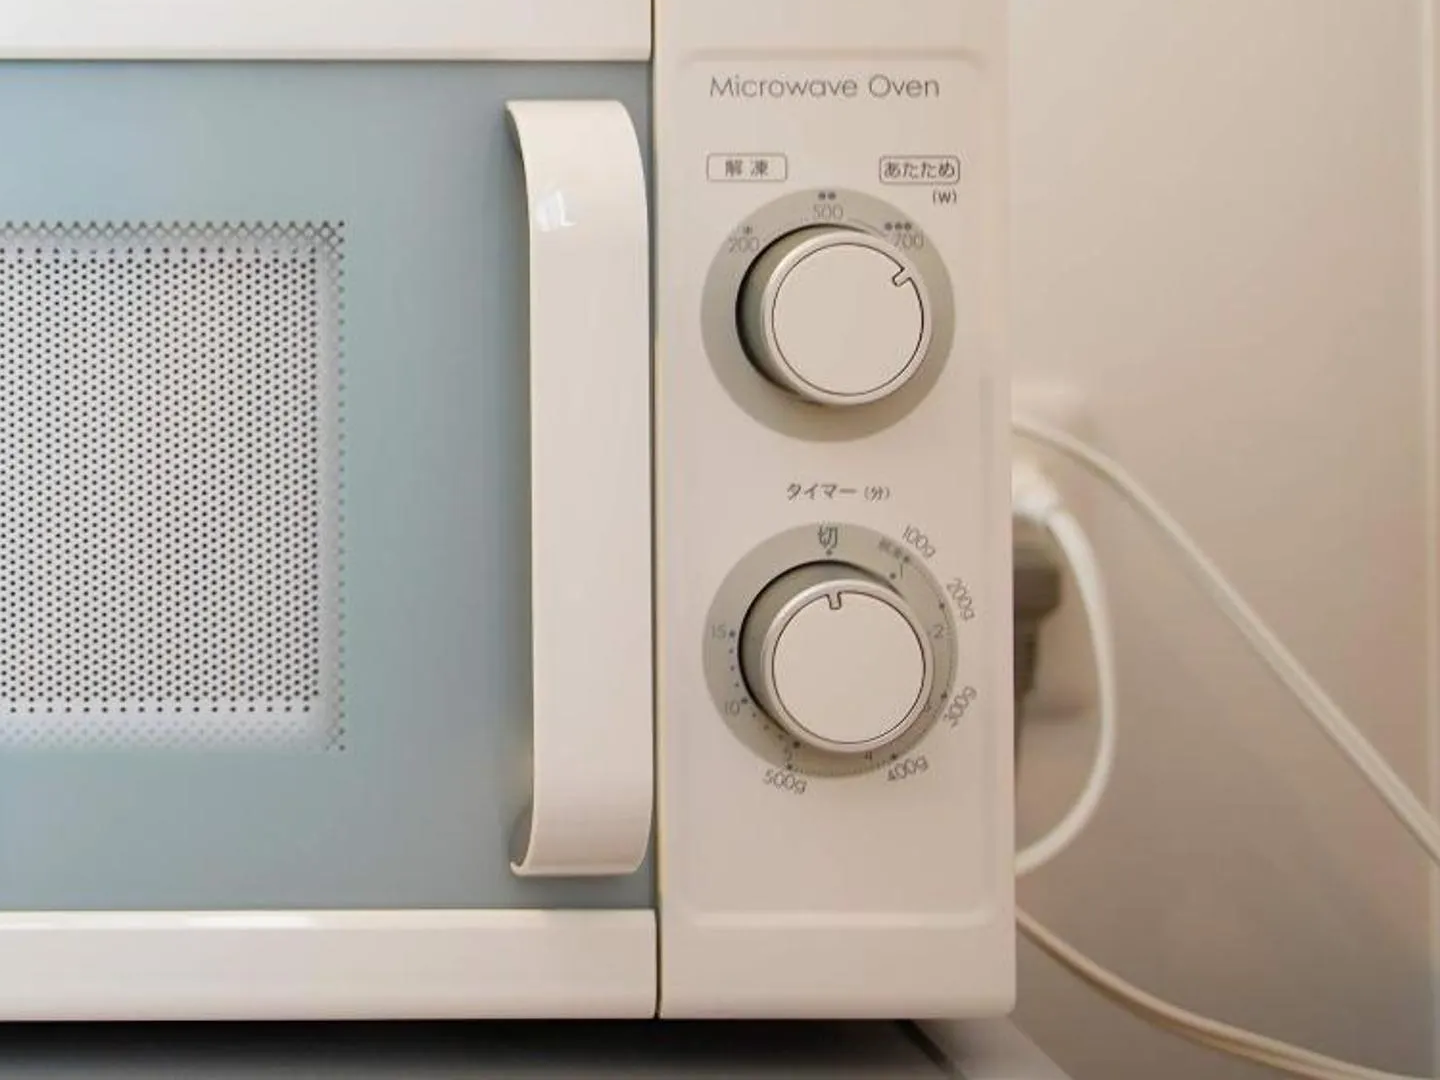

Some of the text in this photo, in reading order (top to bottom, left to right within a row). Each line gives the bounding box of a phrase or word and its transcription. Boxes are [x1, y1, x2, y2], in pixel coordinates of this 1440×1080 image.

[710, 75, 940, 98] Microwave Oven
[725, 159, 769, 177] 解凍
[884, 161, 956, 179] あたため
[786, 482, 858, 501] タイマー
[763, 770, 808, 796] 500g
